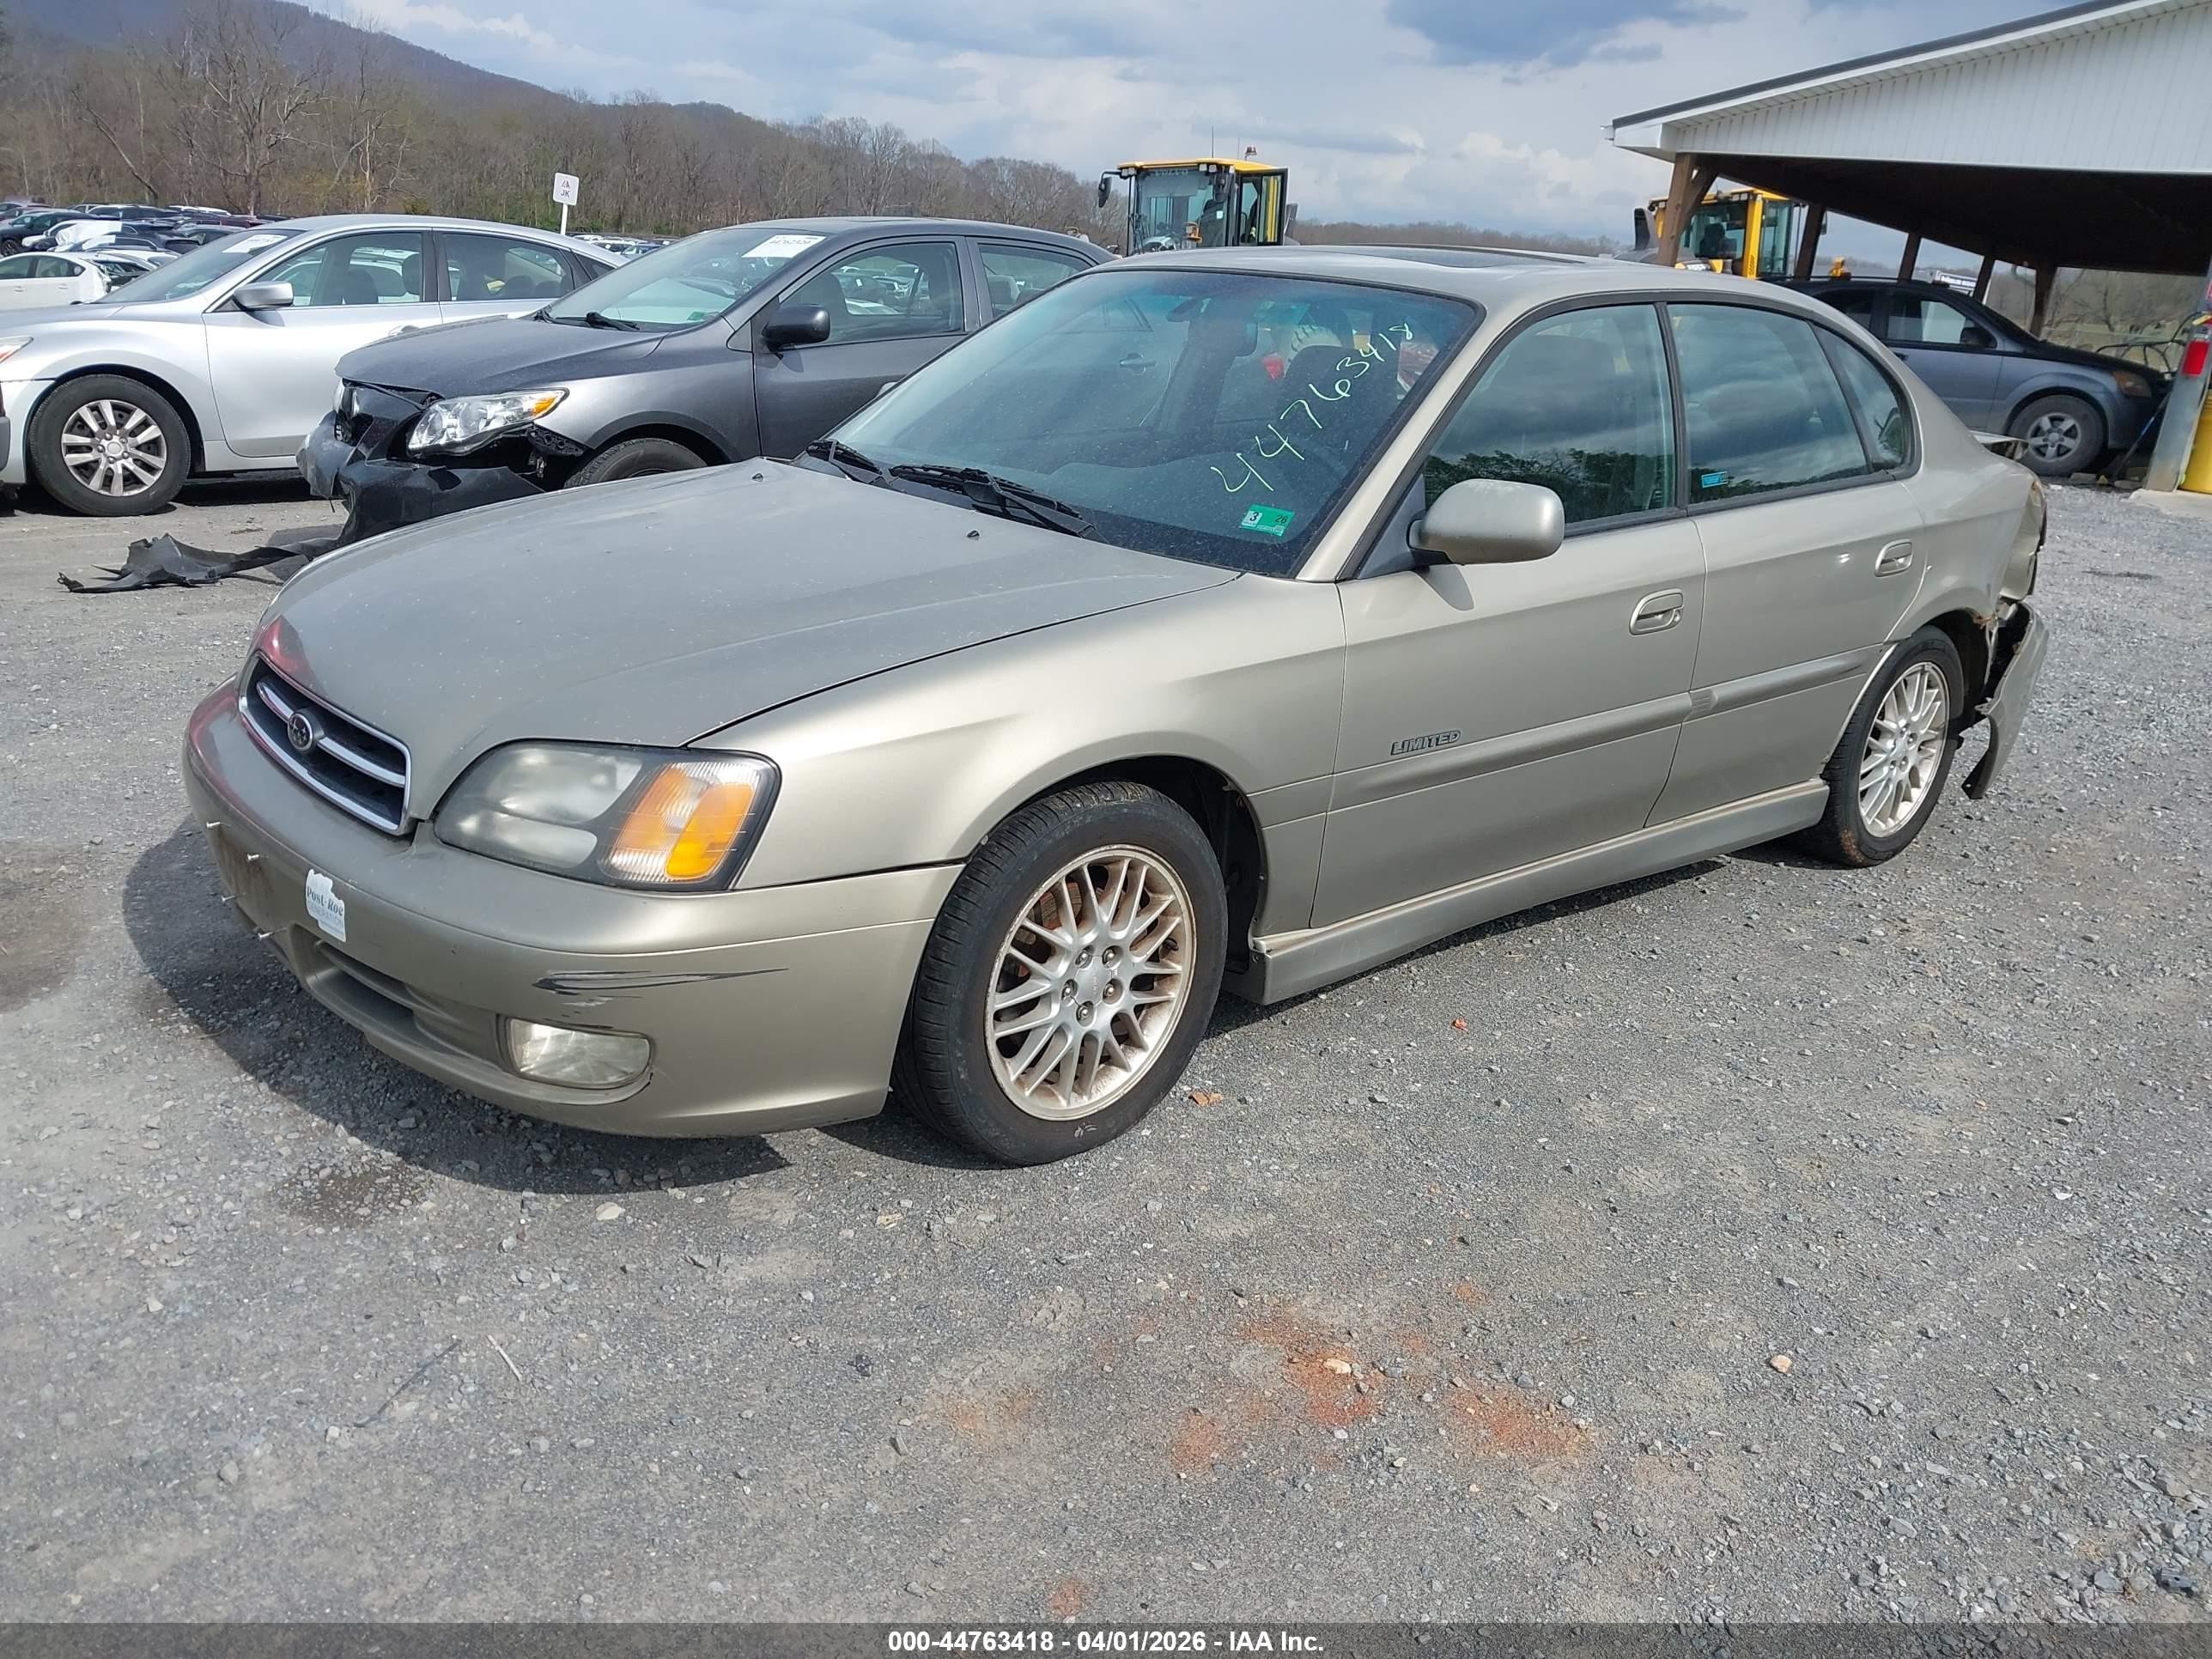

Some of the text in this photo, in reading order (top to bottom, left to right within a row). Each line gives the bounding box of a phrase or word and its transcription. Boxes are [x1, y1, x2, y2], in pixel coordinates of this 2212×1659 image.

[560, 189, 570, 198] JK
[1210, 322, 1414, 492] 44763418
[1249, 511, 1289, 524] 3 26
[1390, 730, 1462, 756] LIMITED
[307, 885, 343, 916] Post-Roe
